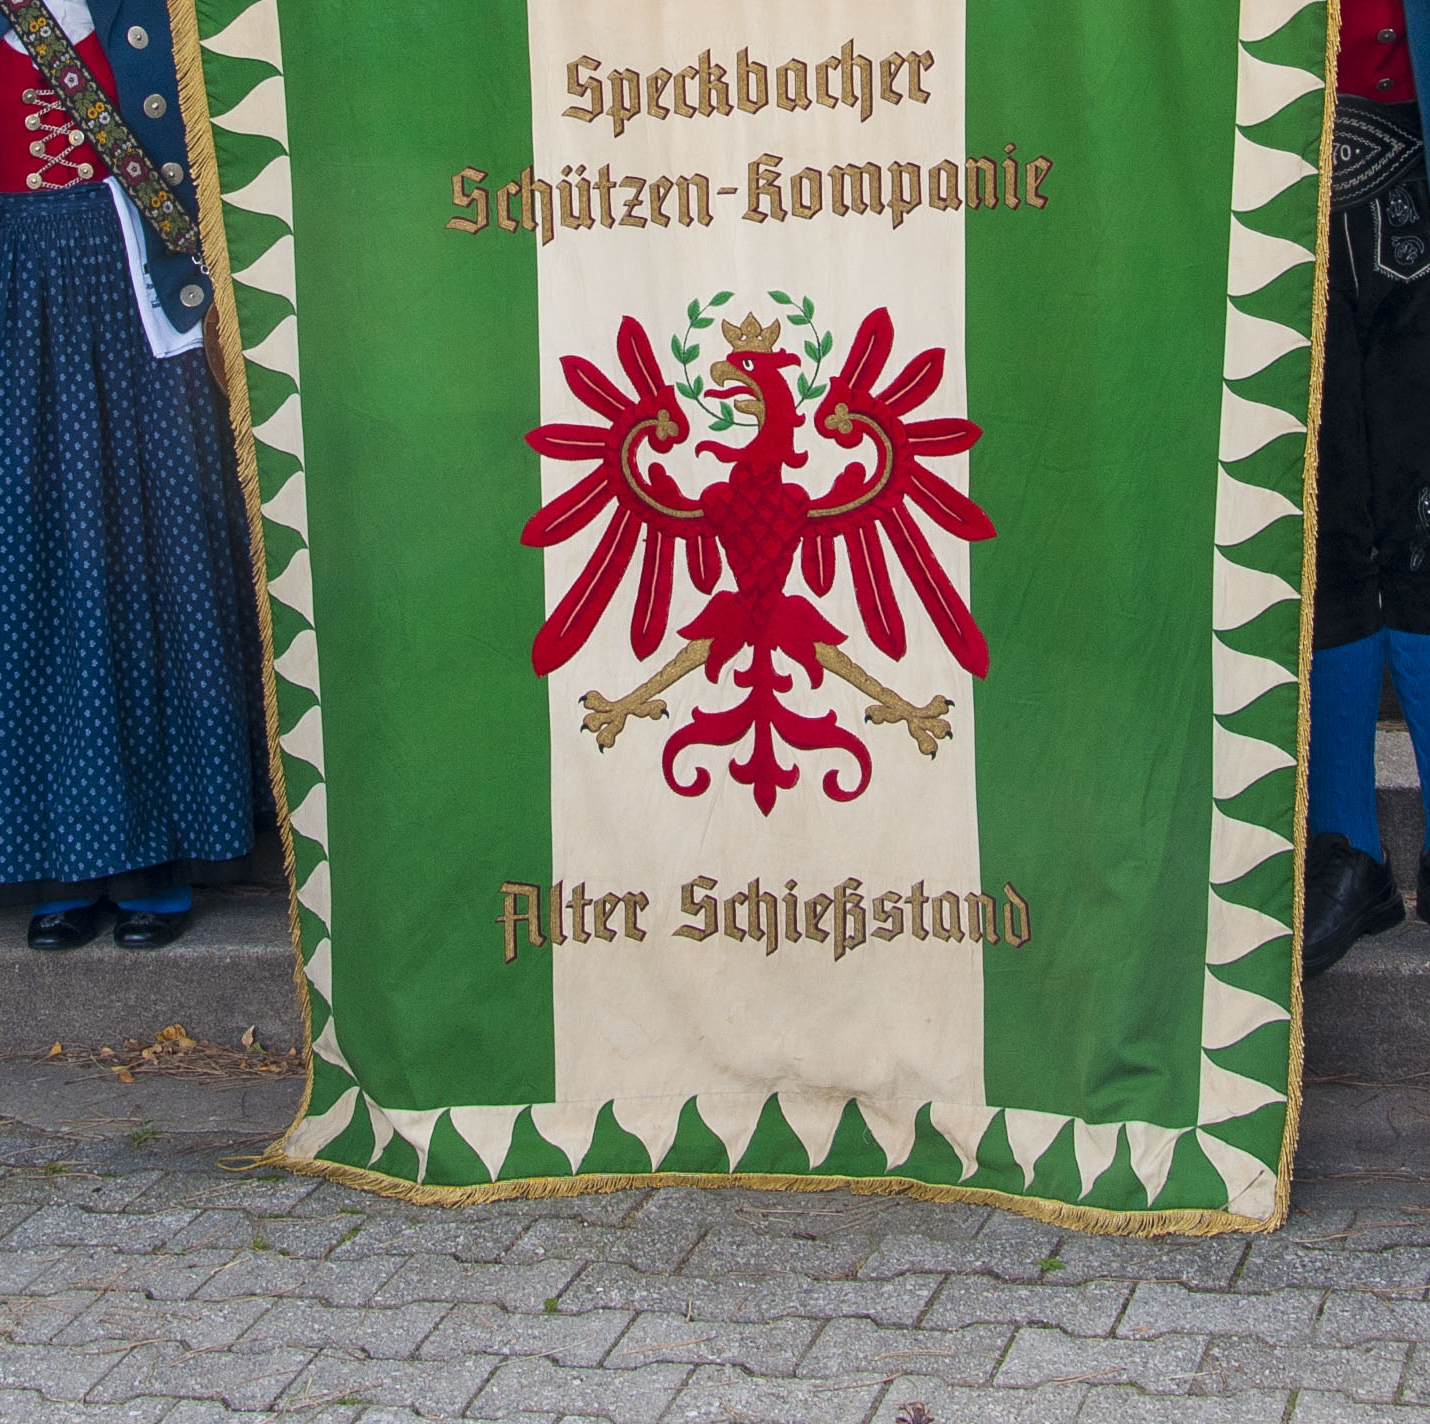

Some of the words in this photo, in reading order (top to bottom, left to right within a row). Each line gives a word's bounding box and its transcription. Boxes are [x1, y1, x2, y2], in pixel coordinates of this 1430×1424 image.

[560, 37, 936, 138] Speckbacher
[444, 141, 1054, 248] Schützen-Kompanie
[494, 878, 650, 965] Alter
[671, 874, 1031, 963] Schießstand
